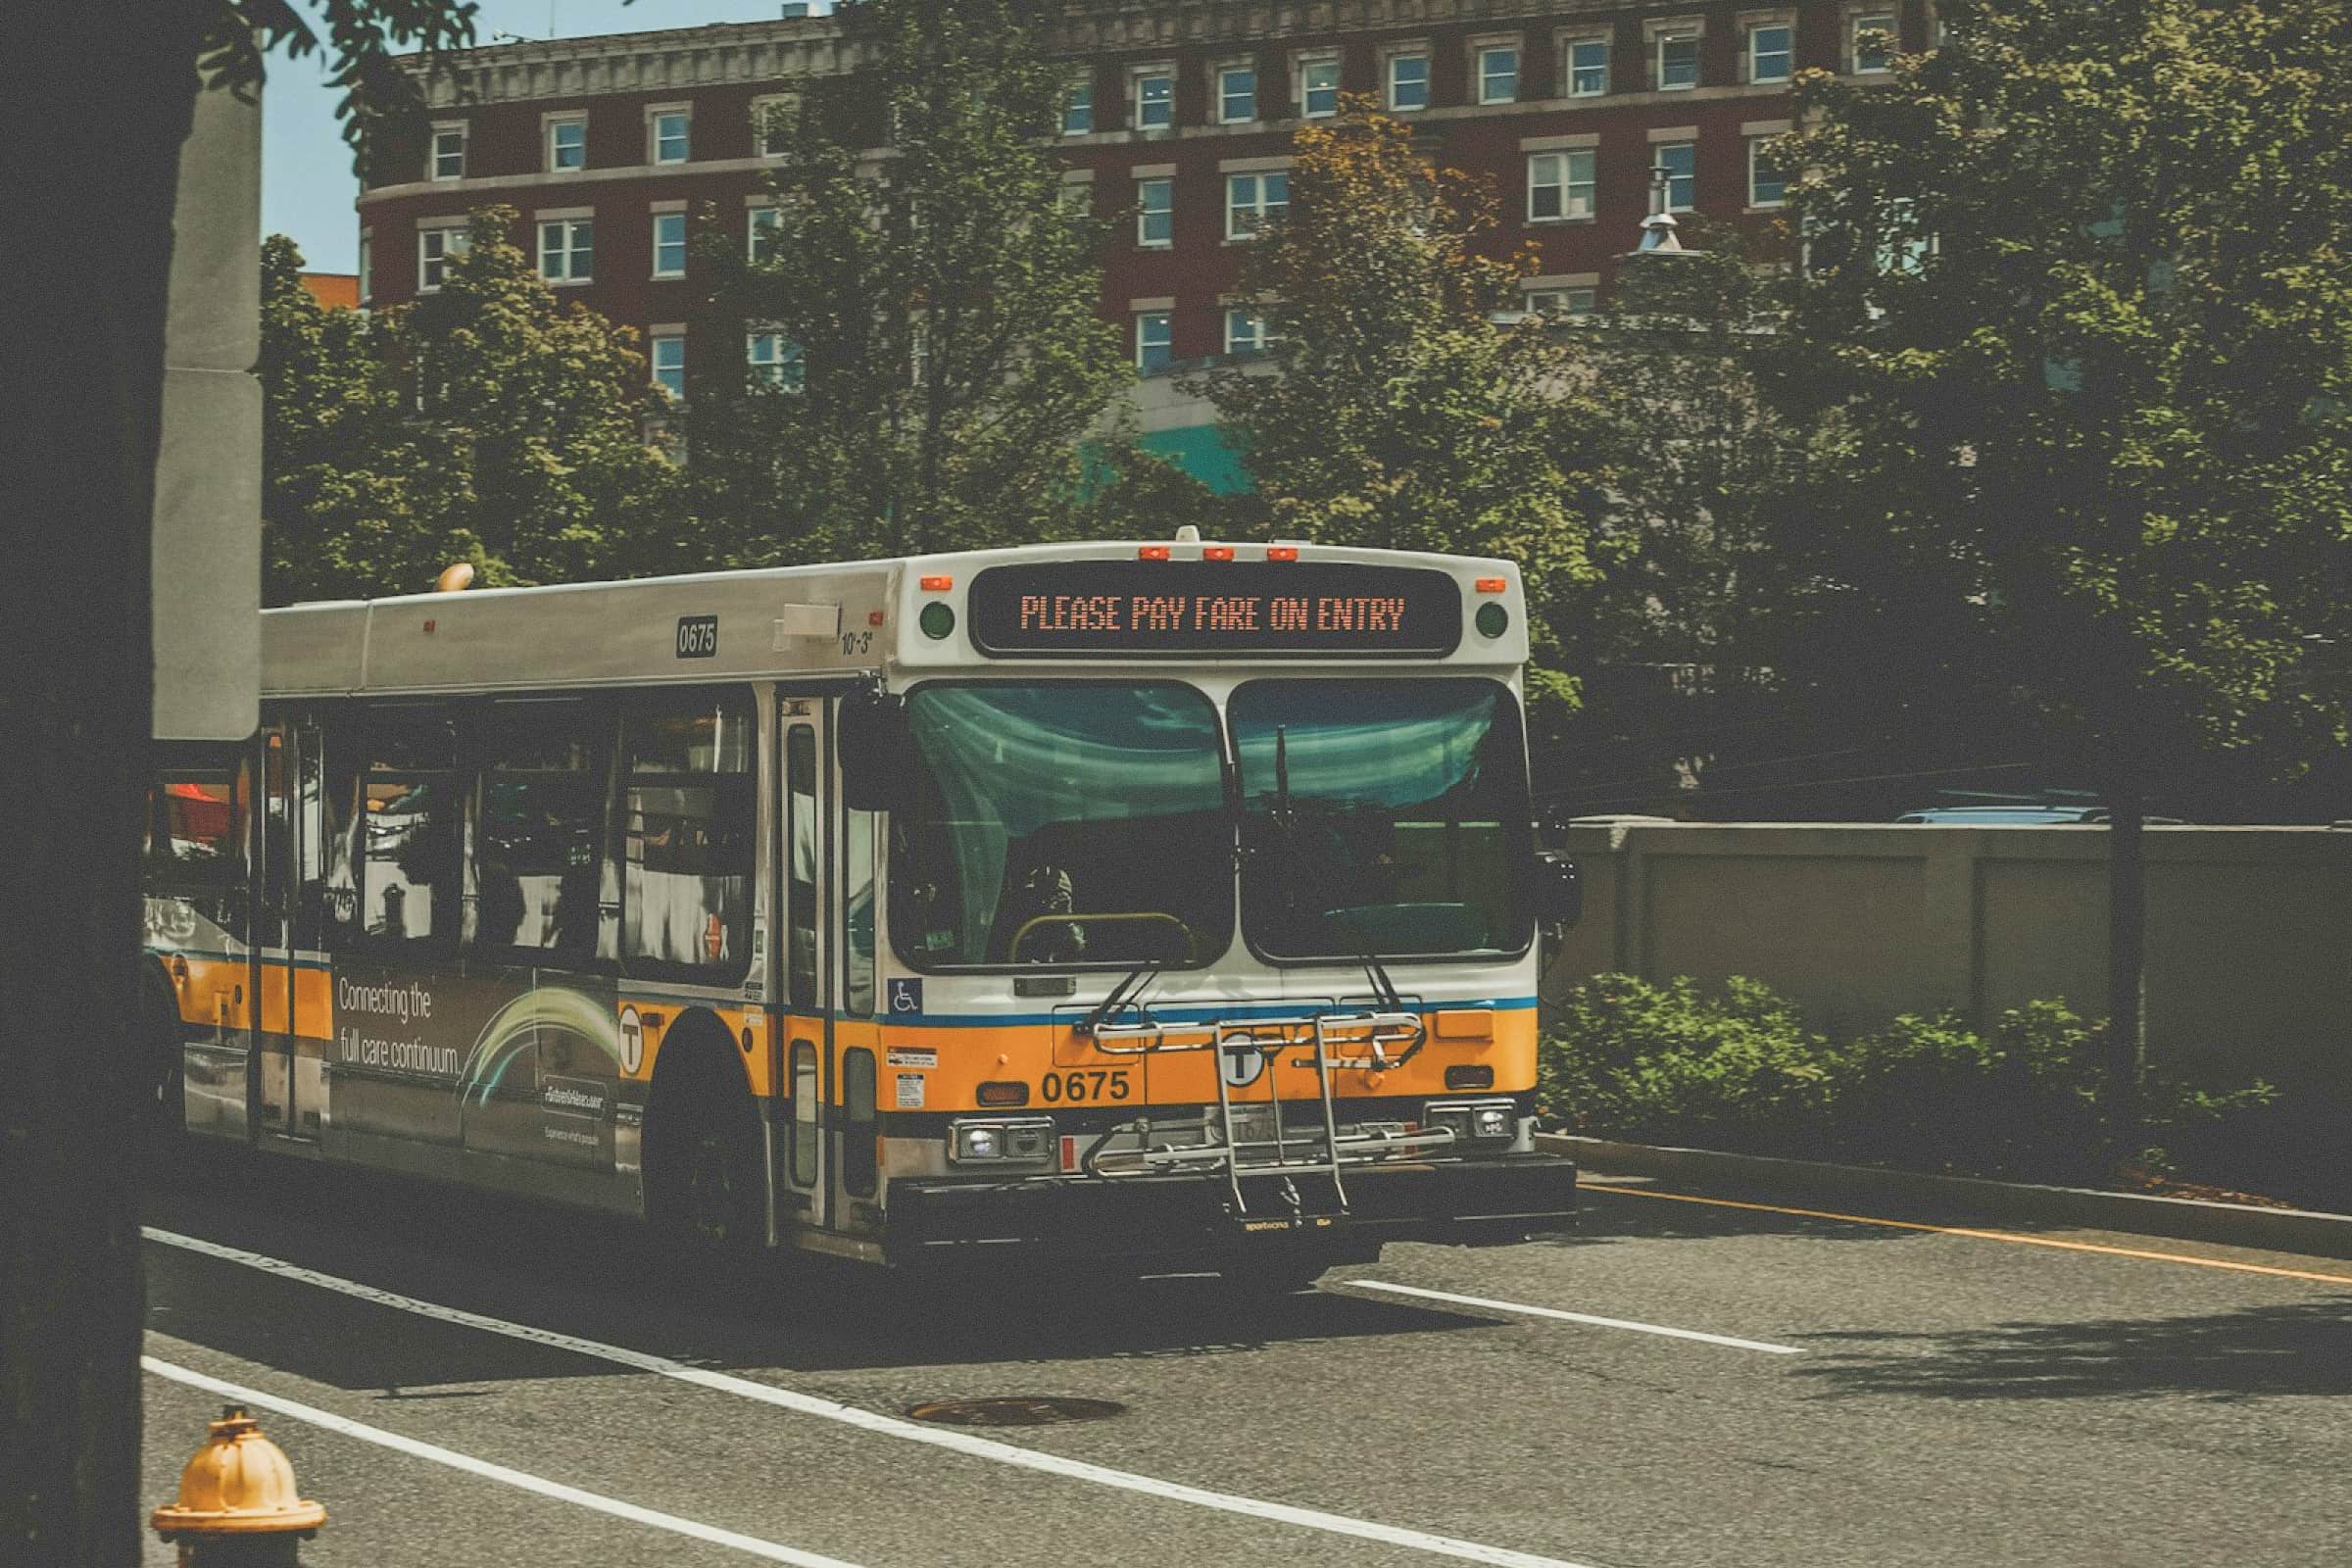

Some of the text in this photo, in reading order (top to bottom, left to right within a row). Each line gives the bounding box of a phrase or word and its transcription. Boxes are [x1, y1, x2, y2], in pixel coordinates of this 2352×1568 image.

[1021, 595, 1405, 631] PLEASE PAY FARE ON ENTRY
[679, 623, 715, 653] 0675
[339, 976, 432, 1025] Connecting the
[340, 1027, 463, 1075] full care continuum.
[622, 1023, 639, 1065] T
[1223, 1046, 1255, 1078] T
[1042, 1071, 1130, 1102] 0675
